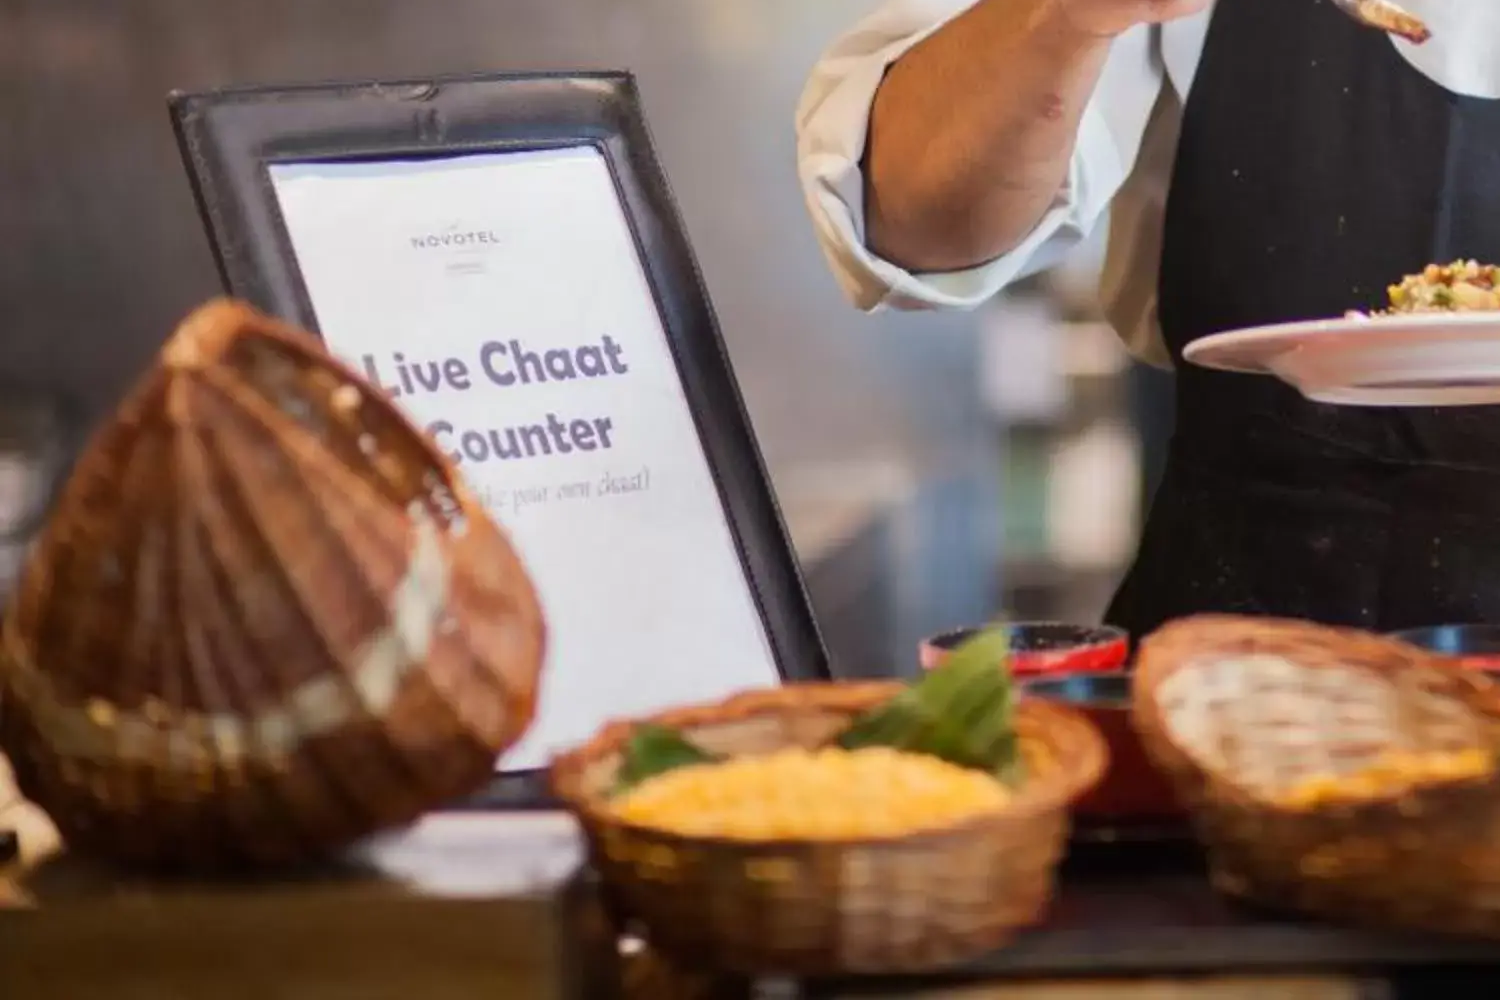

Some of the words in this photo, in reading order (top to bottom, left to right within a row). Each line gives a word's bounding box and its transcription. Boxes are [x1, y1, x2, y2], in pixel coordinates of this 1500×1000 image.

[410, 230, 500, 249] NOVOTEL
[361, 353, 472, 397] Live
[479, 334, 629, 387] Chaat
[427, 412, 613, 464] Counter
